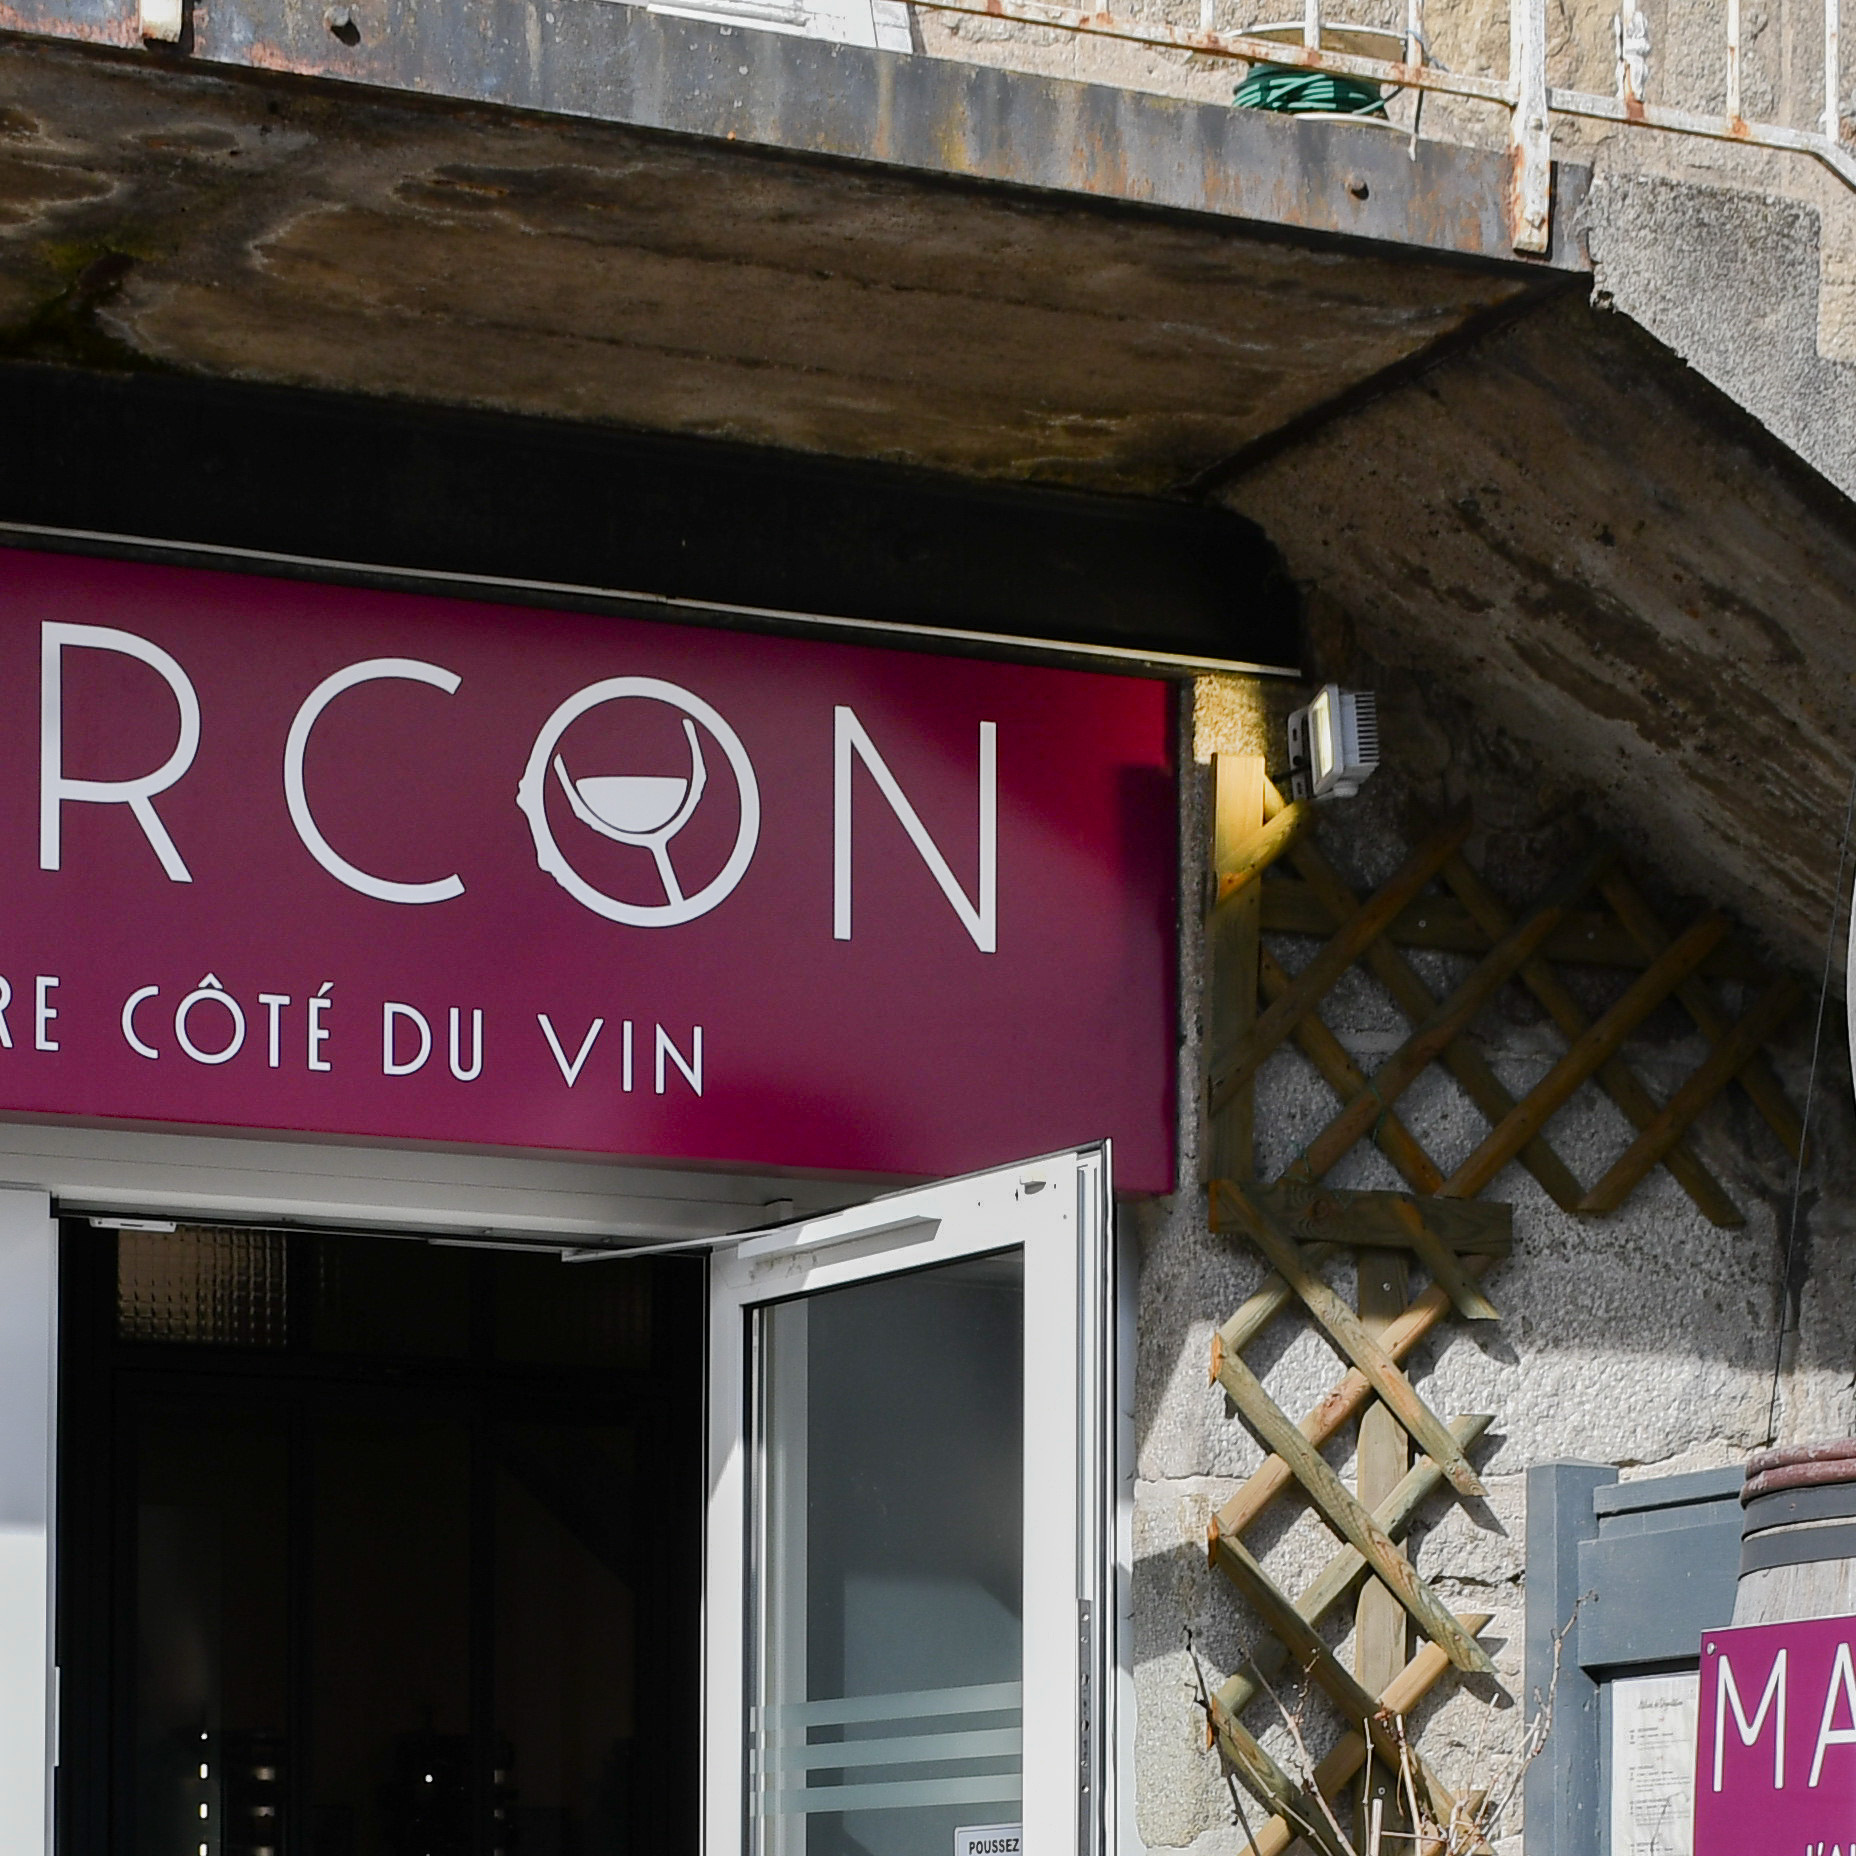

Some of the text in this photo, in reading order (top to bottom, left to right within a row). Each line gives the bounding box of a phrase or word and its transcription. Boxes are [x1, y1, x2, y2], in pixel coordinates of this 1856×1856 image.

[120, 971, 335, 1072] CÔTÉ
[382, 1001, 483, 1082] DU
[536, 1012, 703, 1098] VIN
[968, 1837, 1020, 1855] POUSSEZ
